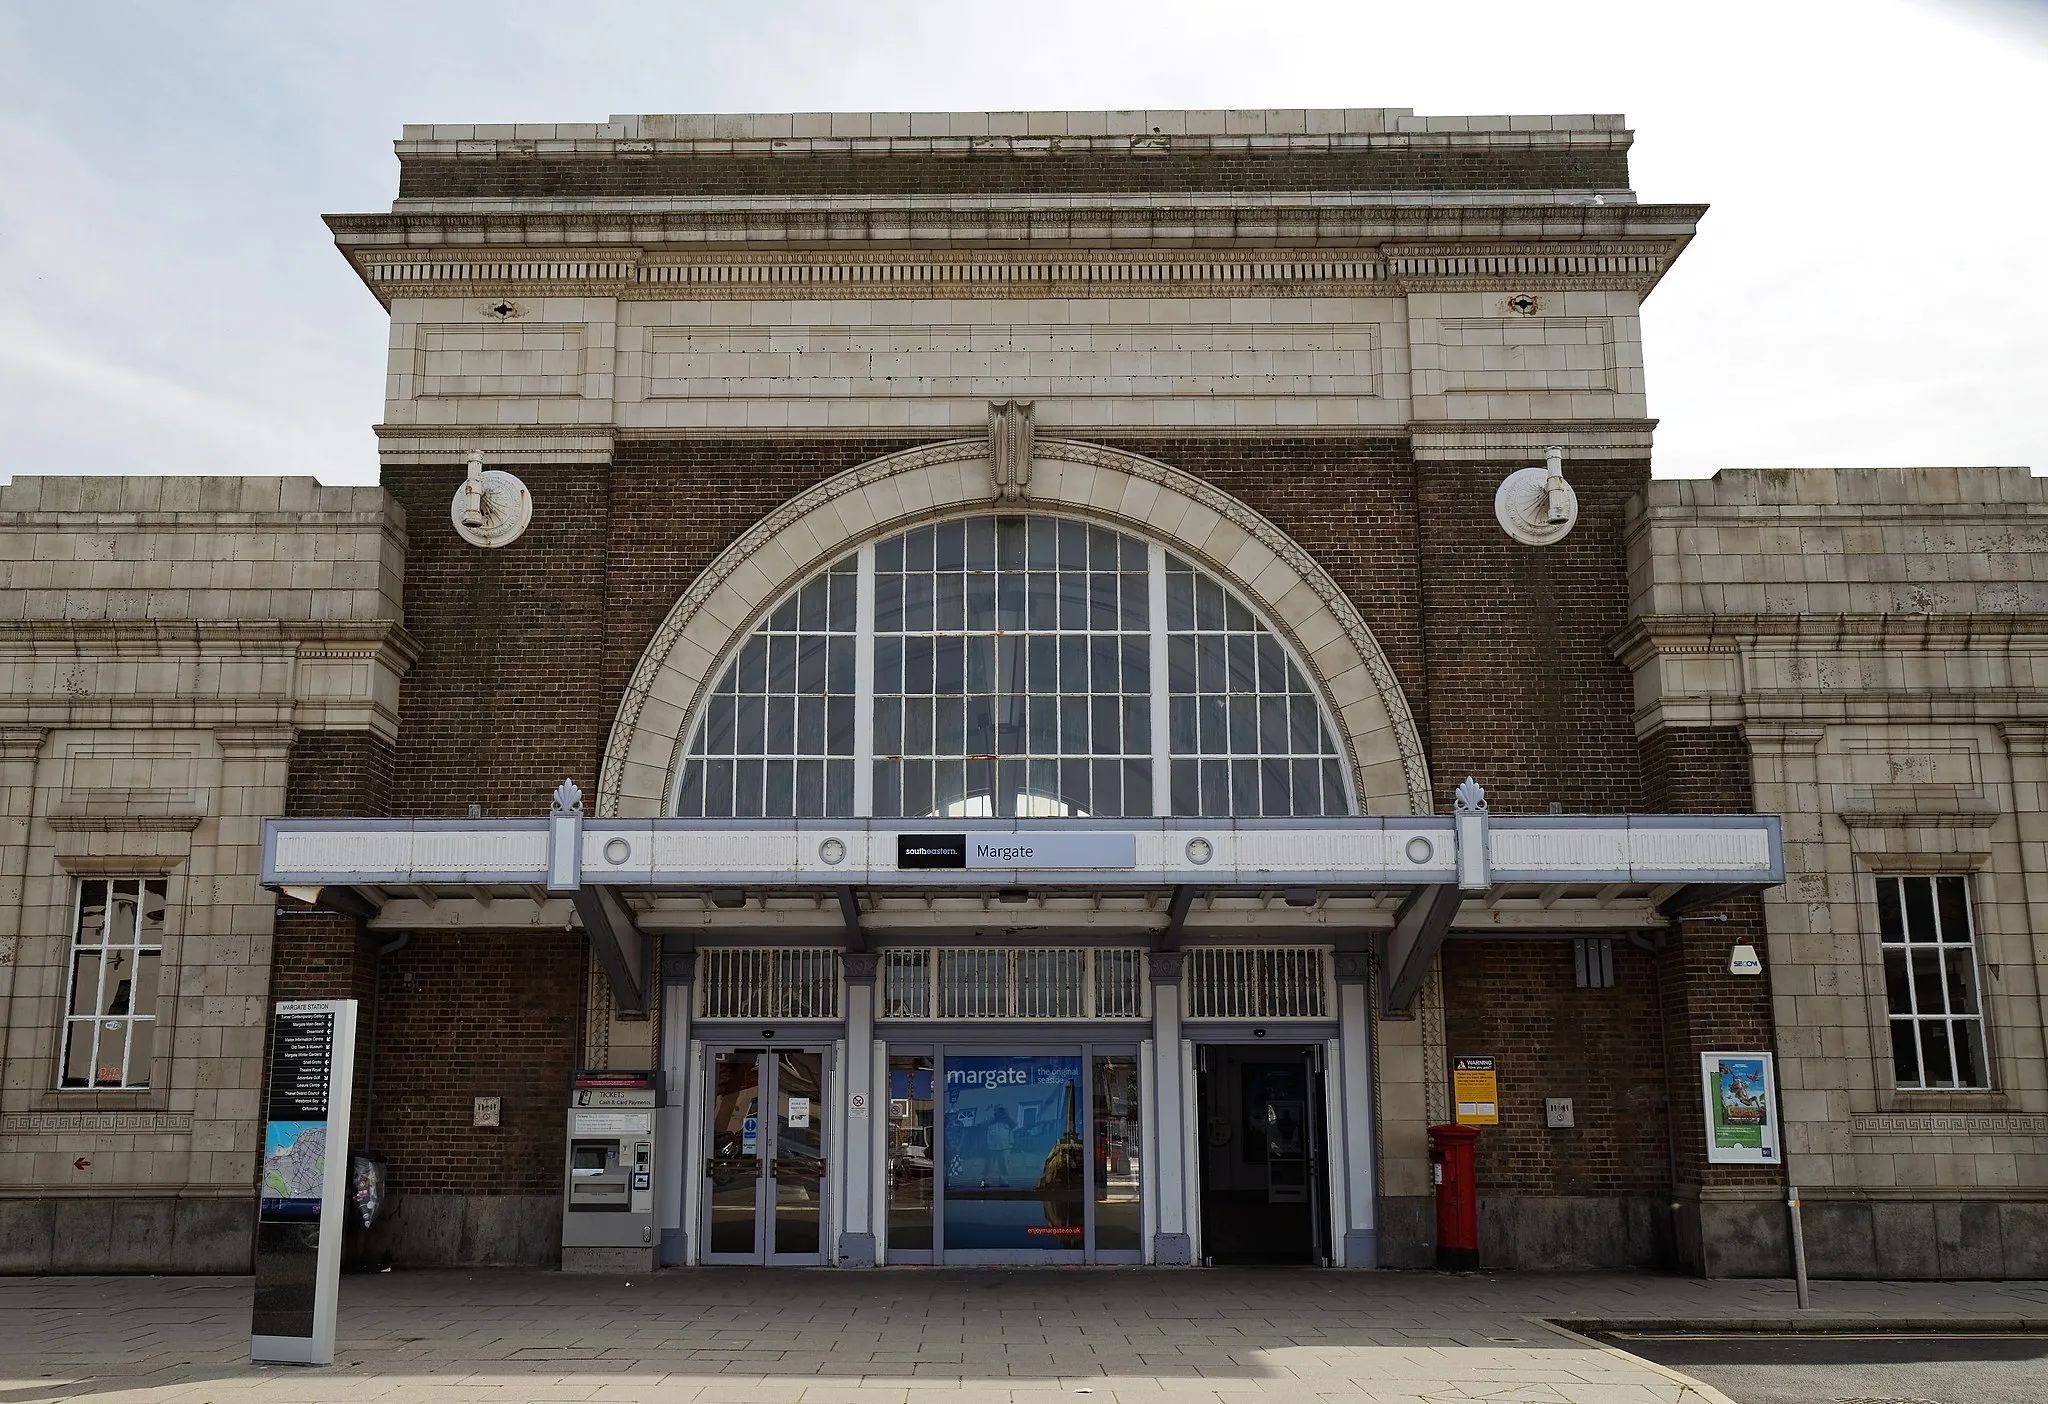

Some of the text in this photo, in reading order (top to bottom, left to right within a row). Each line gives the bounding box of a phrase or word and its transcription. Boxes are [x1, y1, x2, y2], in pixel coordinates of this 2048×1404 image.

[977, 844, 1034, 860] Margate
[947, 1067, 1078, 1089] margate the original
[1038, 1076, 1064, 1084] seaside
